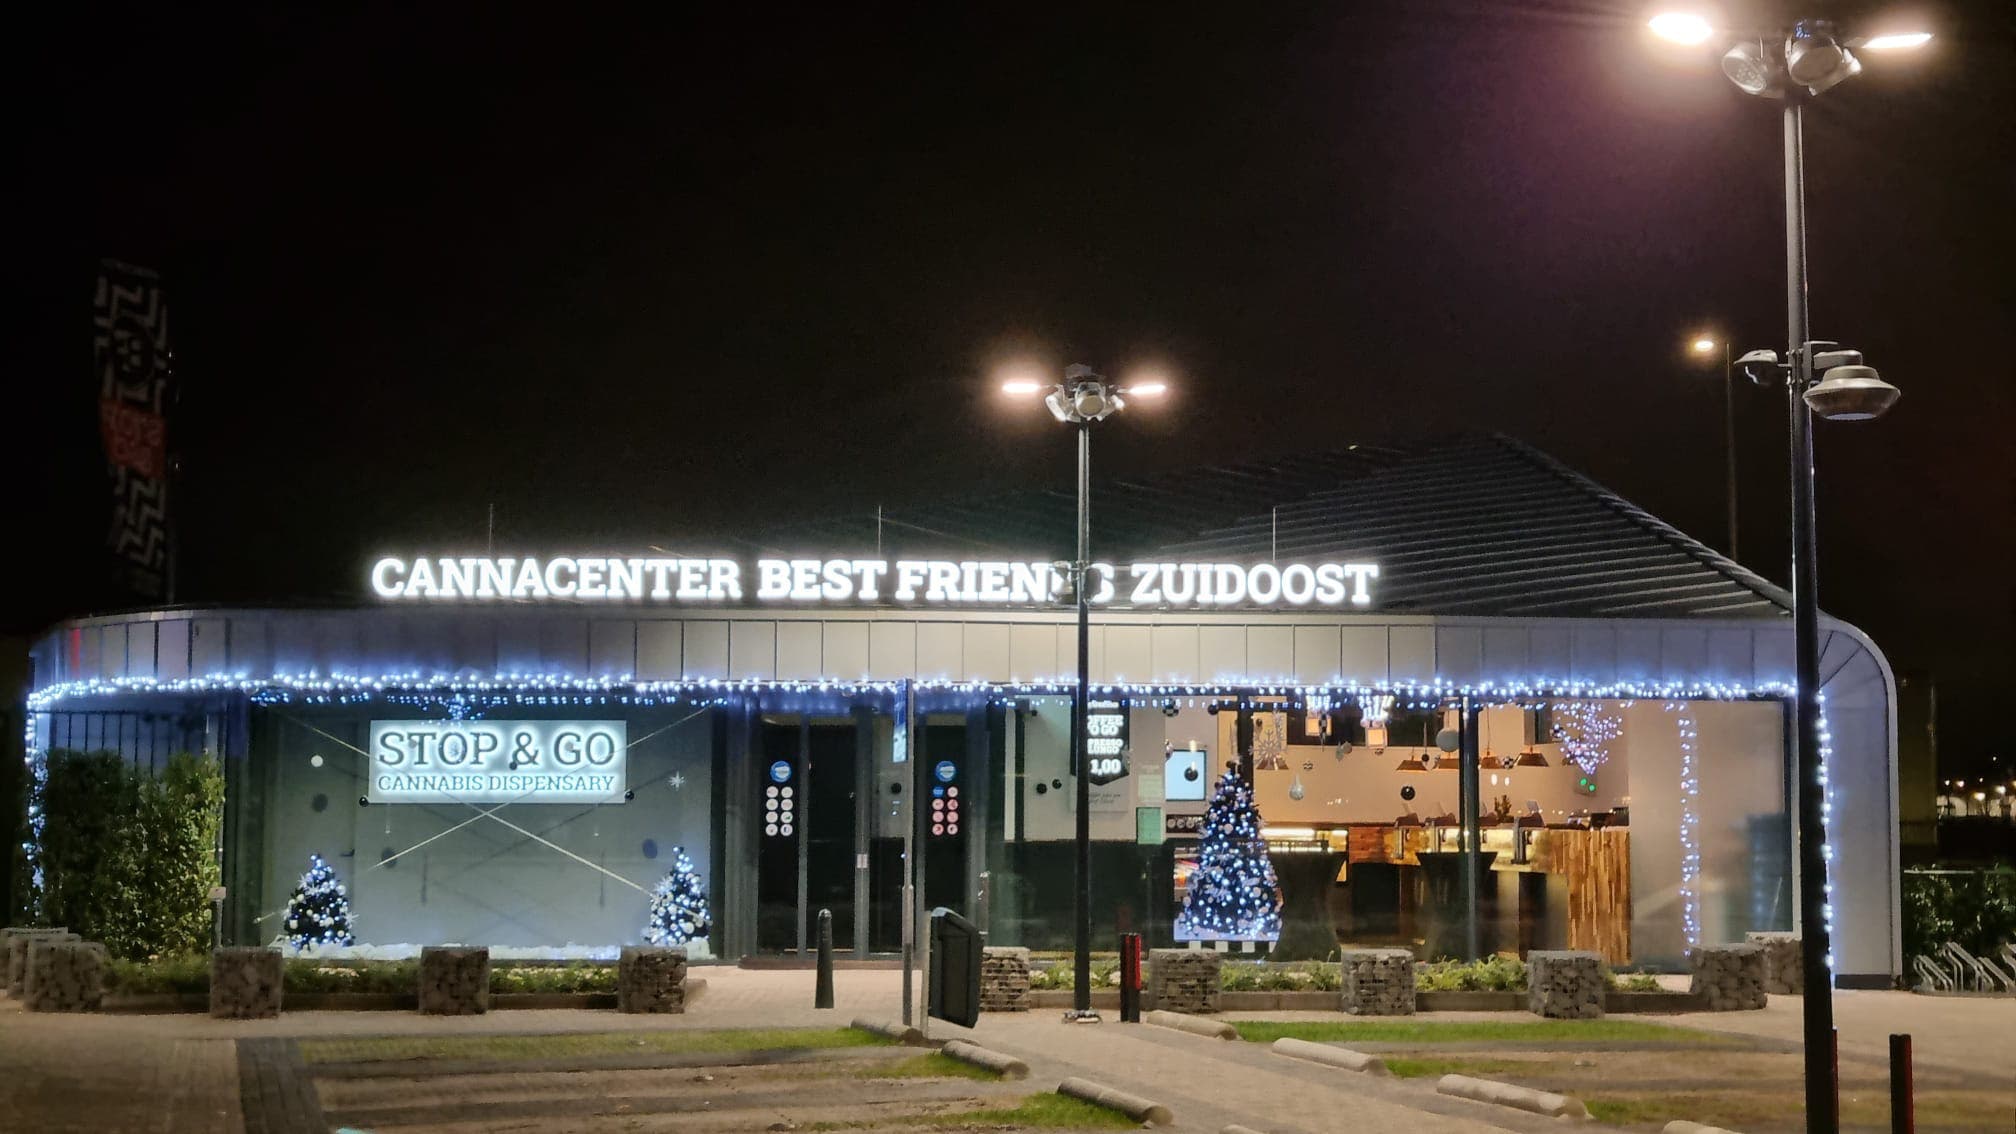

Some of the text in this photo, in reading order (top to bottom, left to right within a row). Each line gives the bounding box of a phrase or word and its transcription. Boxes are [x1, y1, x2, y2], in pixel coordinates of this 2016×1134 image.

[371, 557, 742, 600] CANNACENTER
[757, 559, 887, 600] BEST
[1130, 563, 1379, 604] ZUIDOOST
[379, 731, 616, 766] STOP & GO
[378, 775, 615, 792] CANNABIS DISPENSARY
